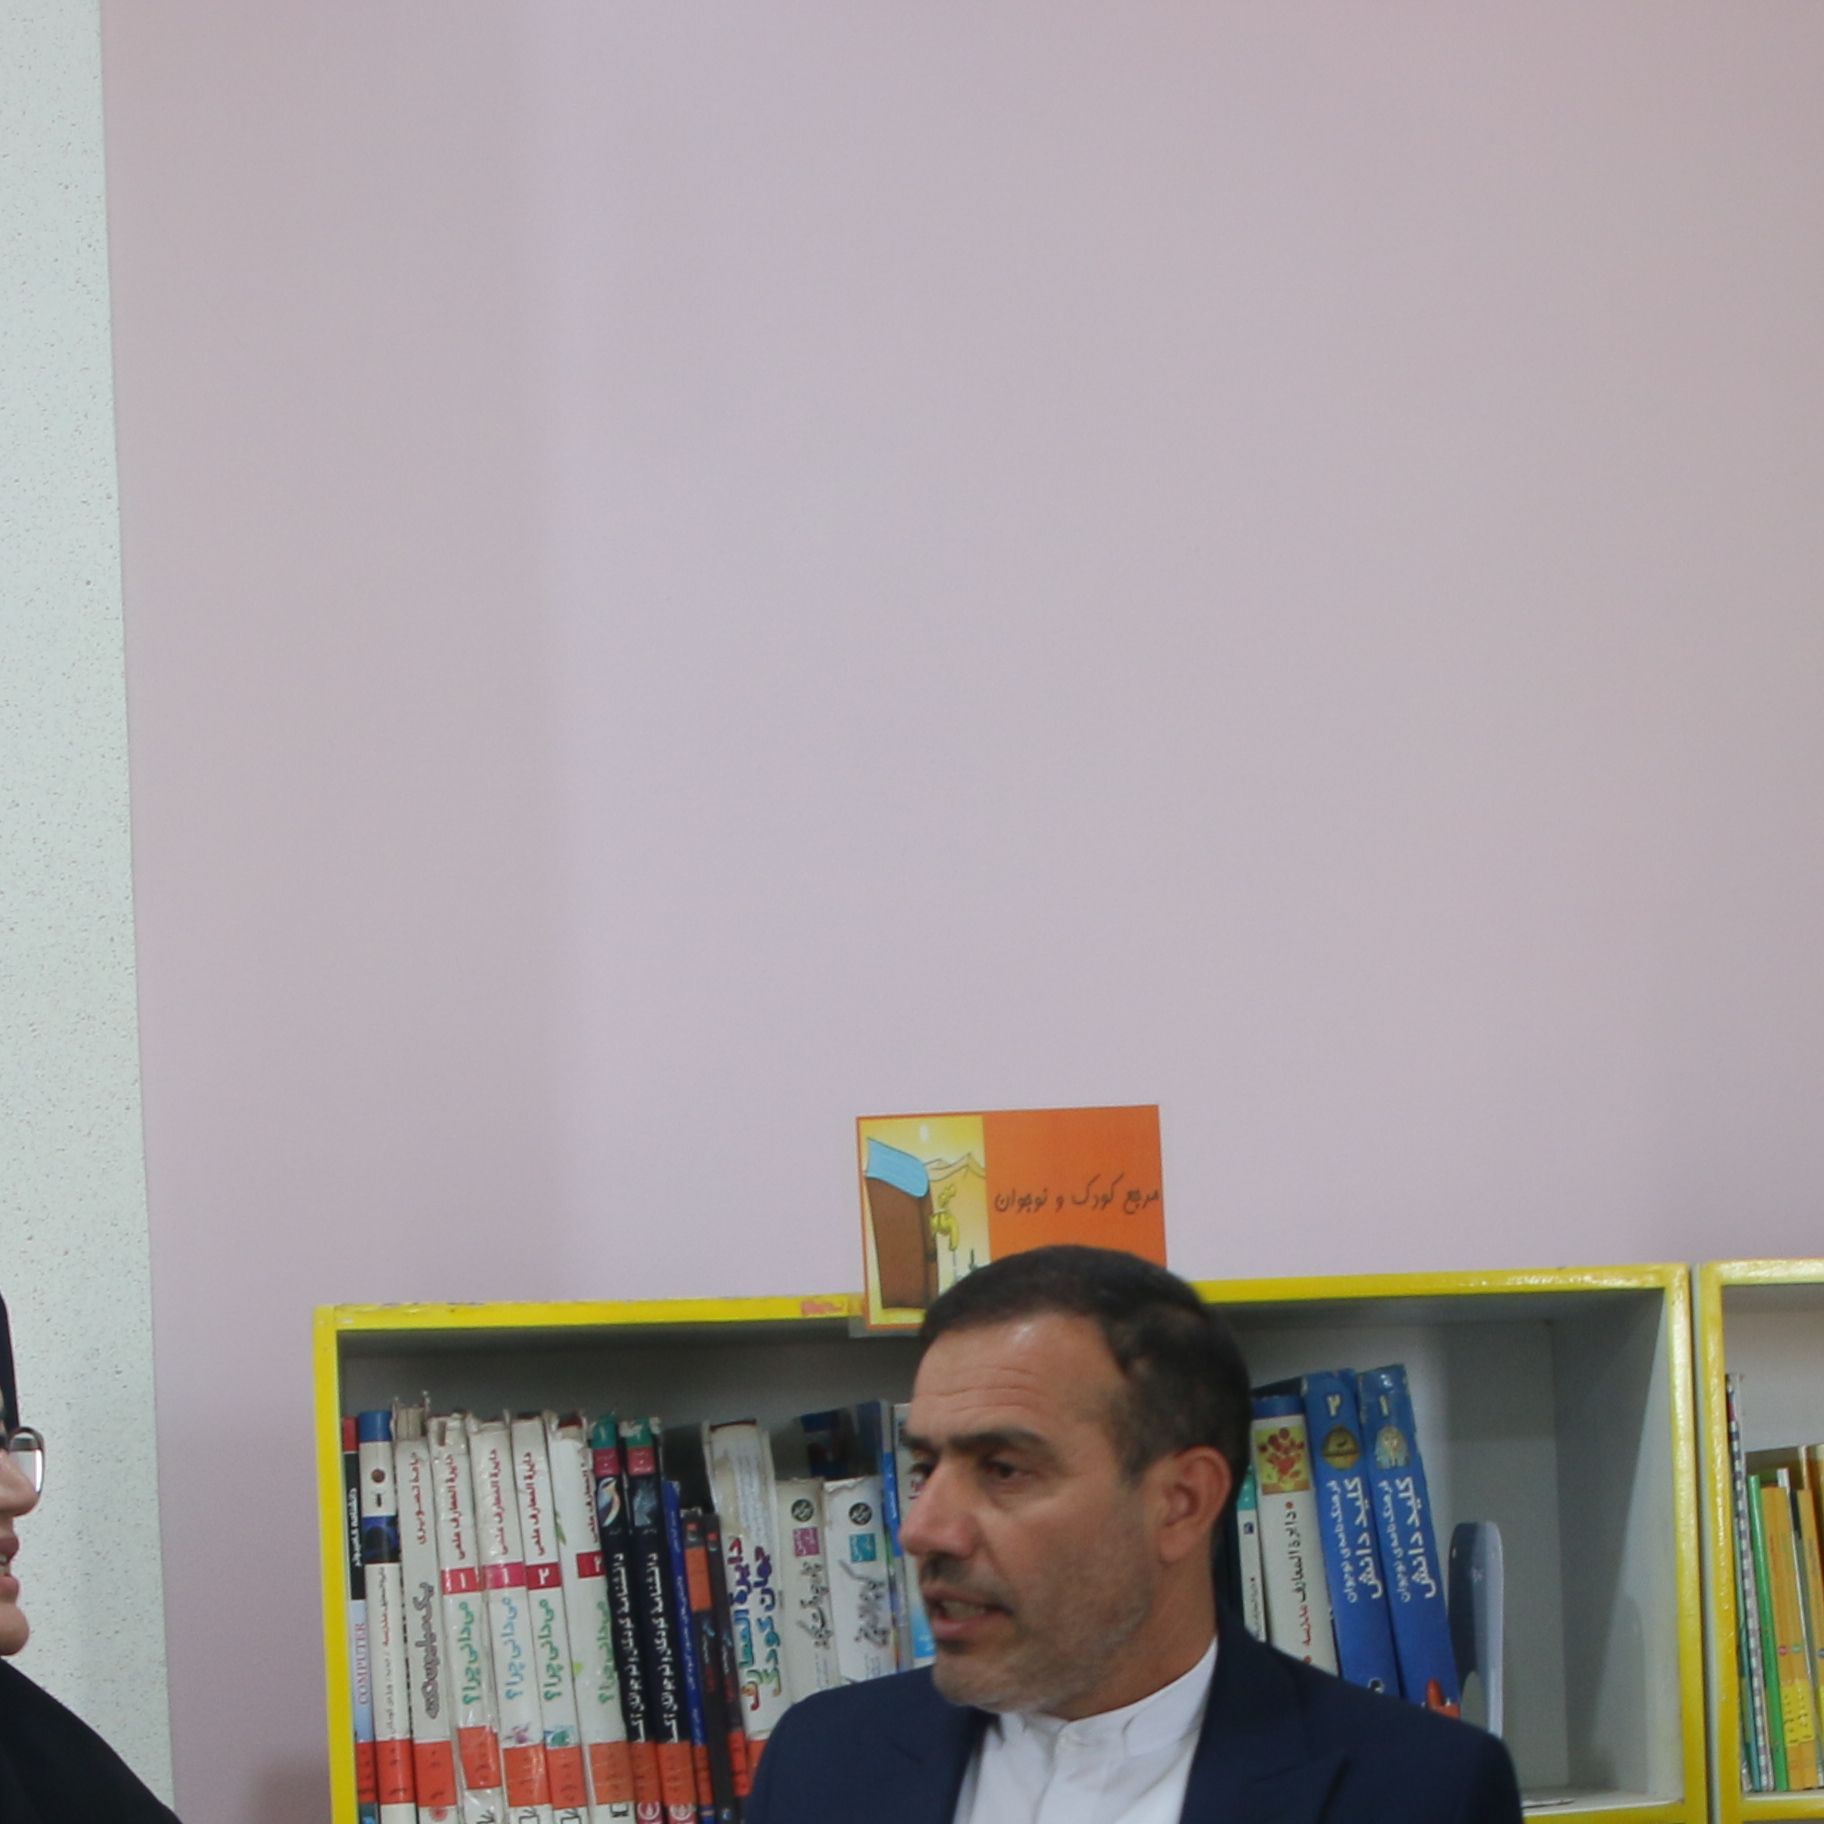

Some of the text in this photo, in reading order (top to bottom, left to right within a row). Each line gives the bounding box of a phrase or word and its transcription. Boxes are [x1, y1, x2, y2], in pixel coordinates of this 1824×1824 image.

[994, 1172, 1160, 1215] مرجع کودک و نوجوان
[412, 1485, 427, 1545] تصویری
[447, 1485, 462, 1529] المعارف
[491, 1481, 505, 1523] المعارف
[526, 1482, 541, 1526] المعارف
[453, 1530, 466, 1560] علمی
[496, 1526, 509, 1556] علمی
[532, 1527, 546, 1556] علمی
[1344, 1476, 1383, 1599] کلید دانش
[1395, 1476, 1436, 1599] کلید دانش
[1284, 1510, 1312, 1647] دایرة المعارف مدرسه
[1340, 1560, 1358, 1603] نوجوان
[1391, 1560, 1411, 1603] نوجوان
[726, 1535, 760, 1711] دایرة المعارف
[752, 1545, 782, 1697] جهان کودک
[354, 1623, 369, 1705] COMPUTER
